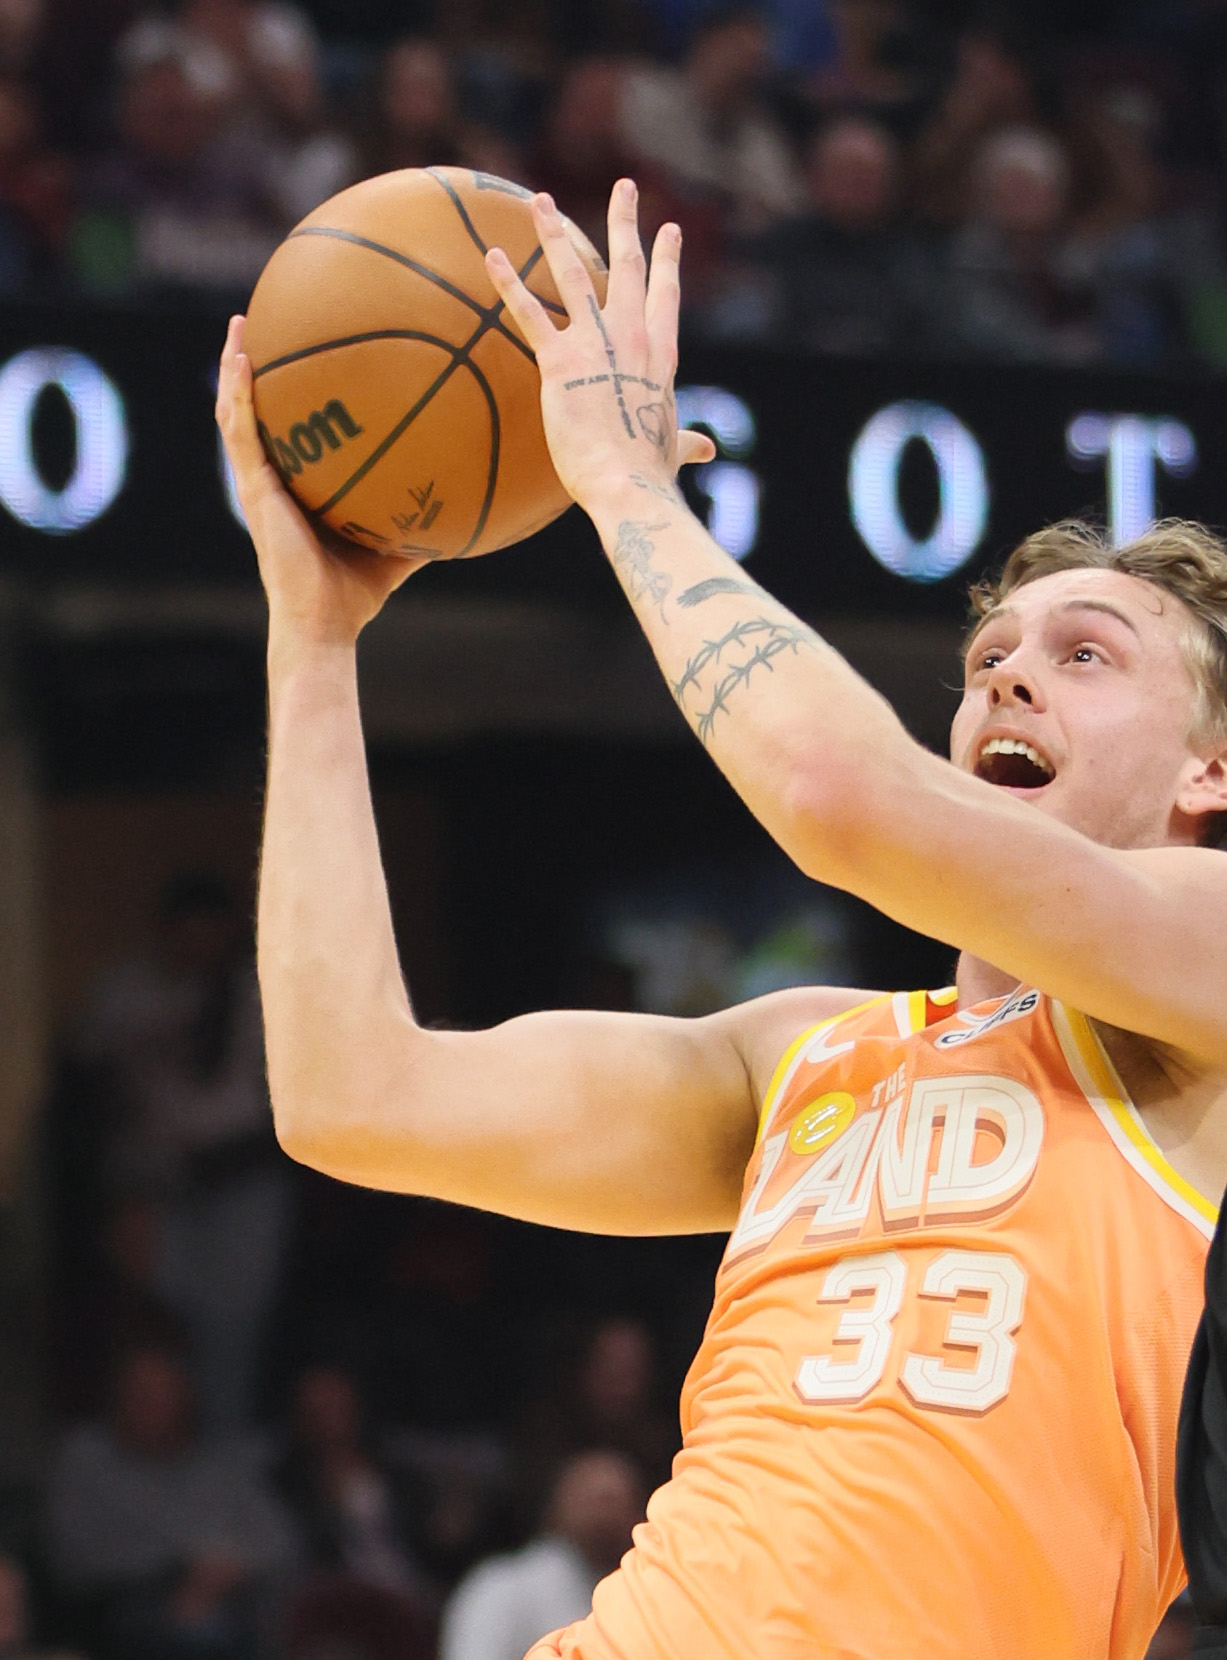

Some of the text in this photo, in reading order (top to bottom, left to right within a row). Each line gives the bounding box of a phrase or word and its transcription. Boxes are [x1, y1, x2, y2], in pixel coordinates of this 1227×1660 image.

[871, 1061, 906, 1108] THE
[722, 1074, 1046, 1274] LAND
[793, 1250, 1027, 1417] 33
